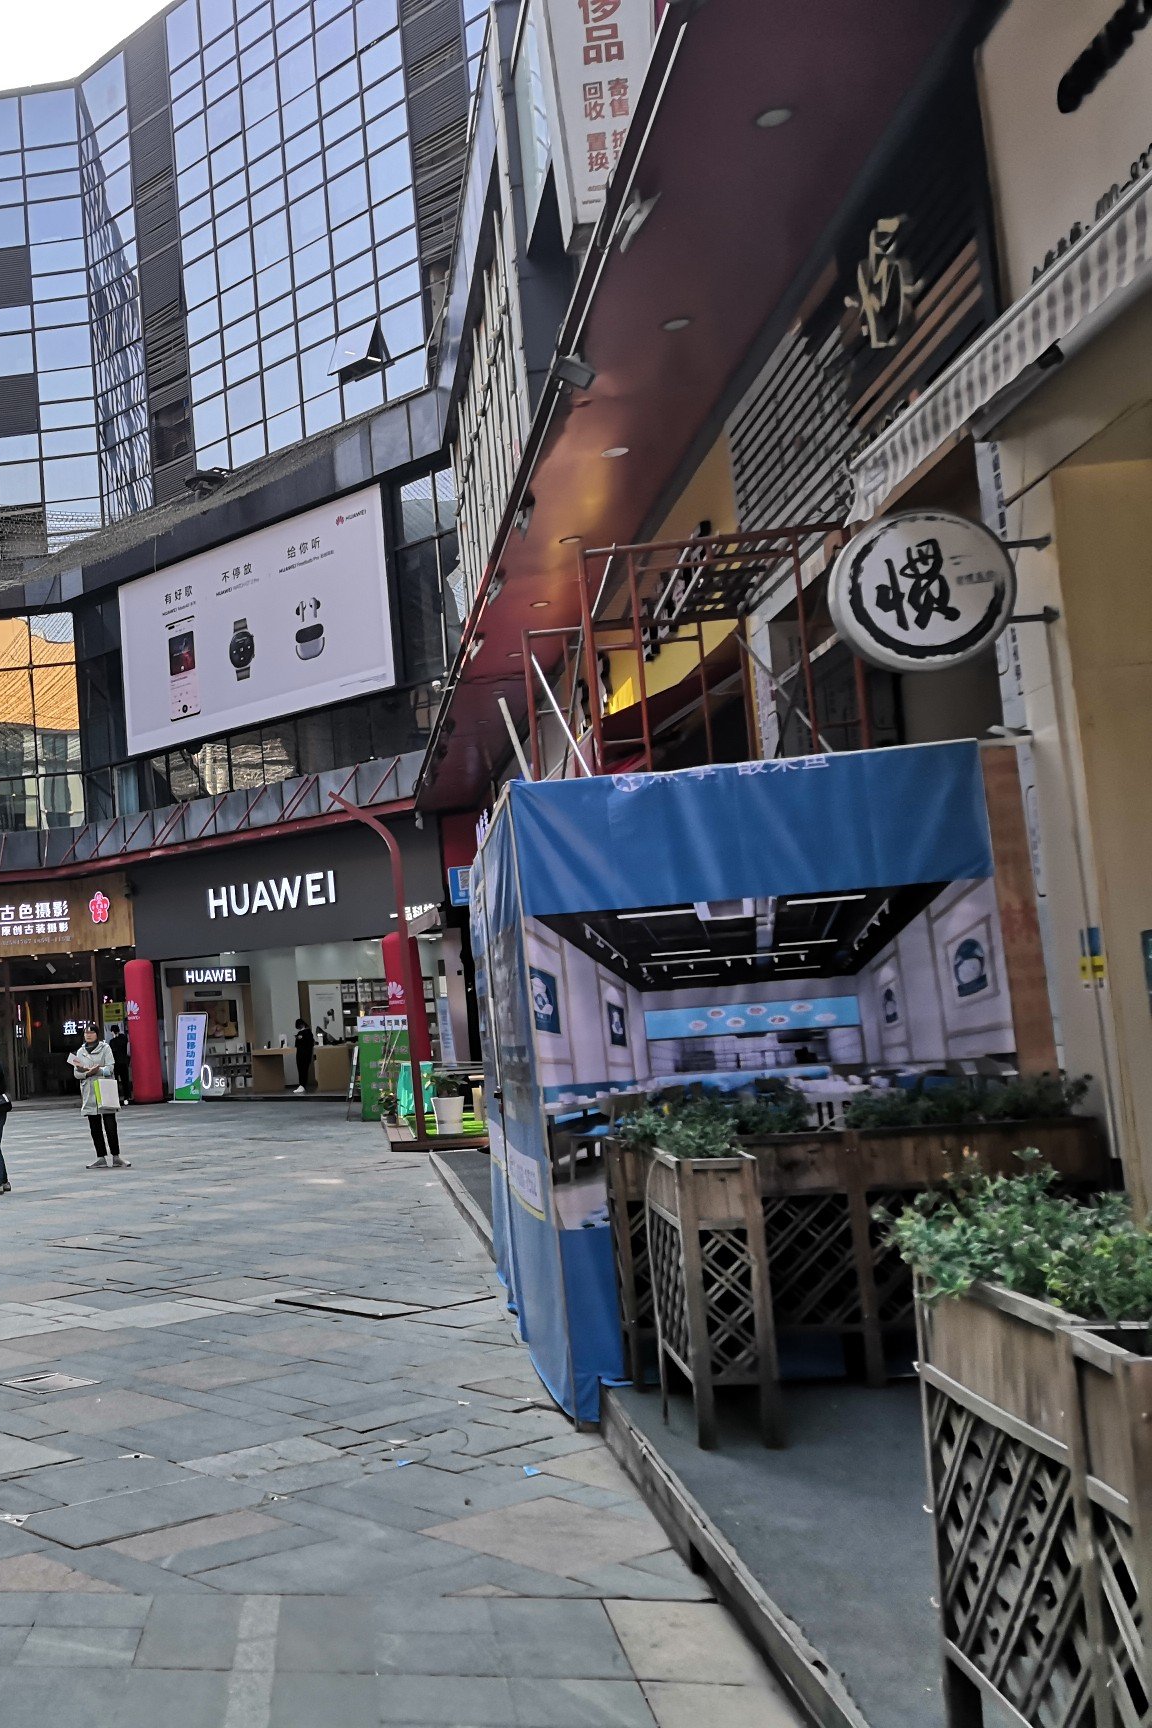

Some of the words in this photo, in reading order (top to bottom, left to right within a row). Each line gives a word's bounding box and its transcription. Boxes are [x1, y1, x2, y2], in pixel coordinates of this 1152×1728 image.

[345, 509, 367, 521] HUAWEI
[287, 536, 320, 559] 给你听
[208, 870, 336, 919] HUAWEI
[185, 968, 237, 983] HUAWEI
